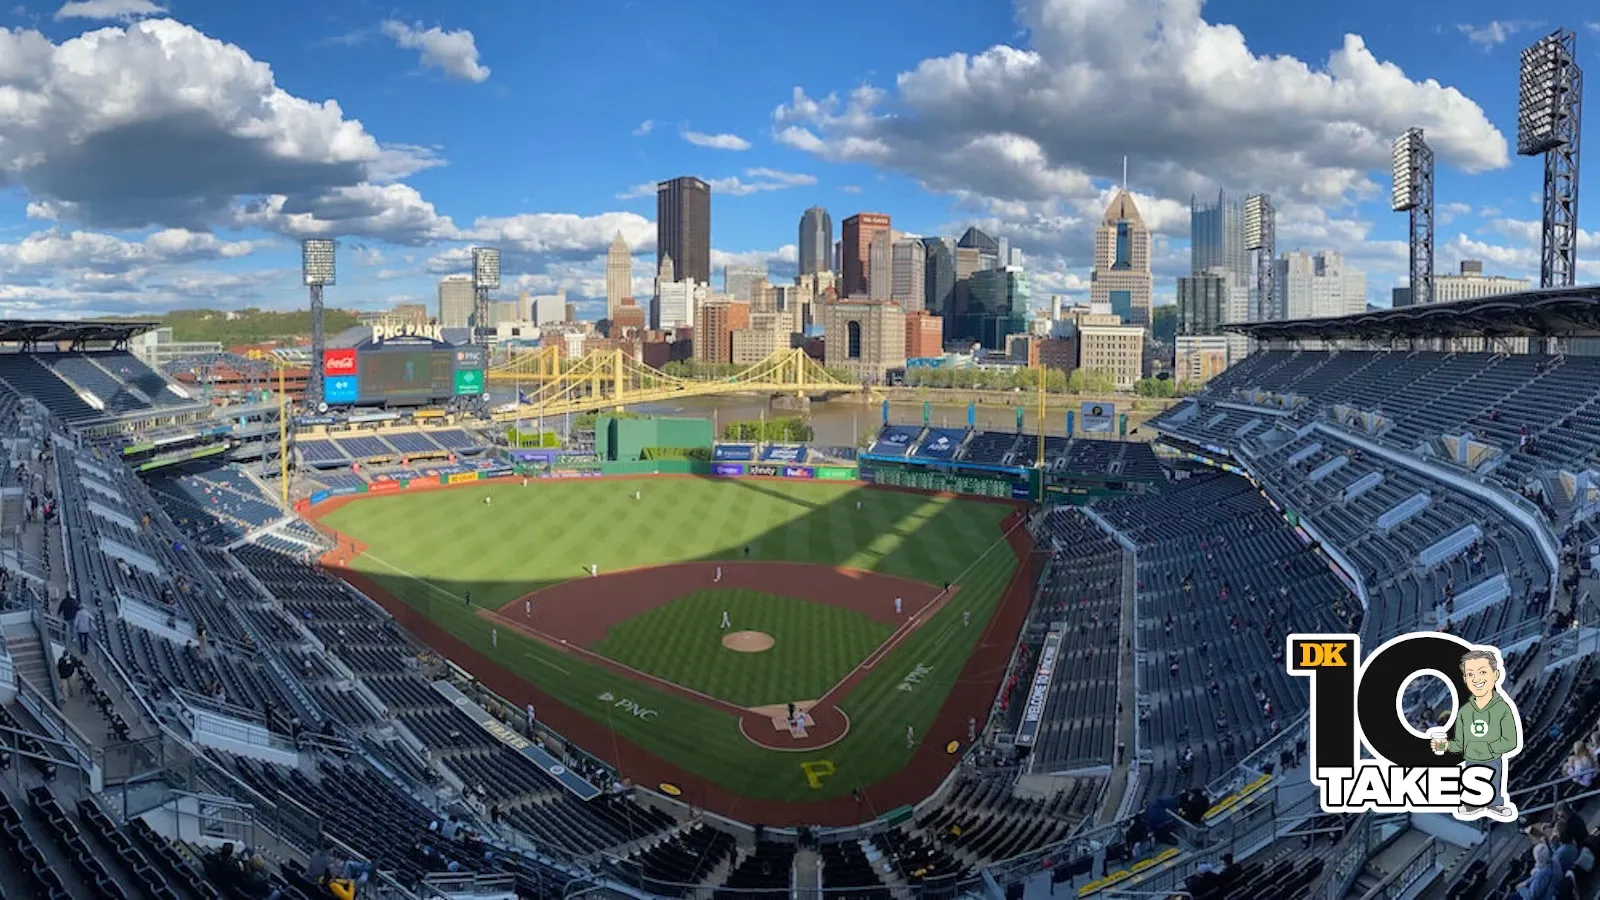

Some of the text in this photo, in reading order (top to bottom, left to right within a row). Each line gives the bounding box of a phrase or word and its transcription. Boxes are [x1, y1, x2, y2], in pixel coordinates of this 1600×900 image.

[372, 324, 445, 345] PNC PARK
[614, 699, 659, 721] PNC
[801, 760, 836, 789] P
